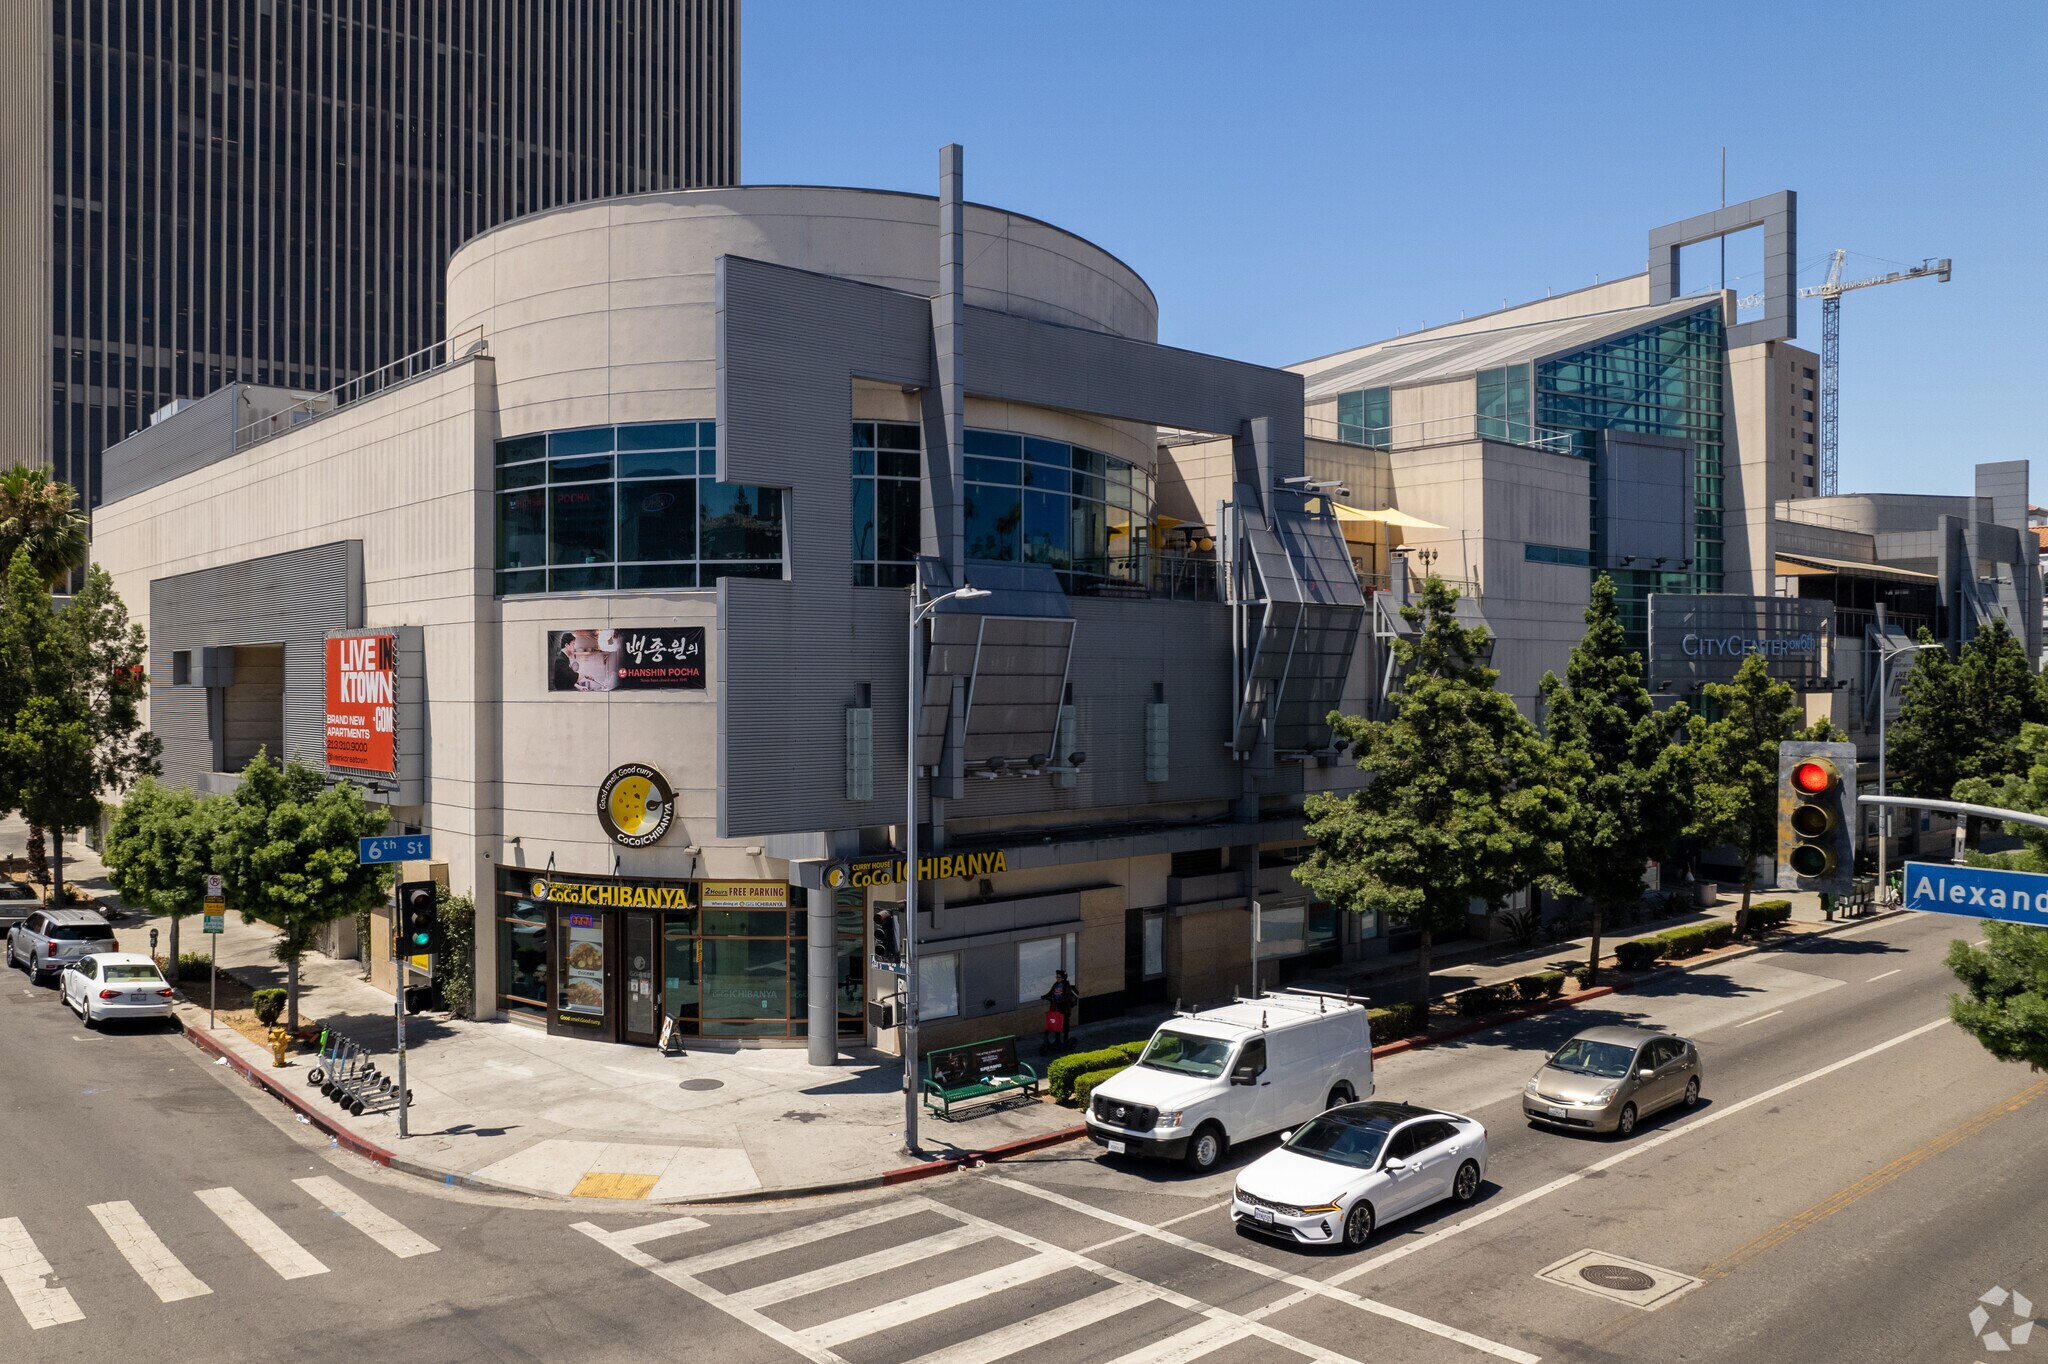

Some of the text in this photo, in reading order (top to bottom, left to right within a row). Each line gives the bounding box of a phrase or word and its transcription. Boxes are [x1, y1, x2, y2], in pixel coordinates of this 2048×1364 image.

[341, 637, 392, 671] LIVE IN
[626, 634, 699, 664] 백종원의
[628, 668, 667, 677] HANSHIN
[668, 667, 700, 676] POCHA
[341, 671, 393, 704] KTOWN
[326, 714, 366, 726] BRAND NEW
[327, 727, 371, 739] APARTMENTS
[599, 789, 608, 809] Good
[618, 766, 636, 777] Good
[636, 767, 654, 778] curry
[368, 840, 424, 860] 6th St
[852, 861, 892, 871] CURRY HOUSE
[852, 869, 891, 888] CoCo
[550, 885, 688, 908] CoCo ICHIBANYA
[729, 887, 747, 896] FREE
[749, 887, 784, 897] PARKING
[729, 990, 777, 999] ICHIBANYA
